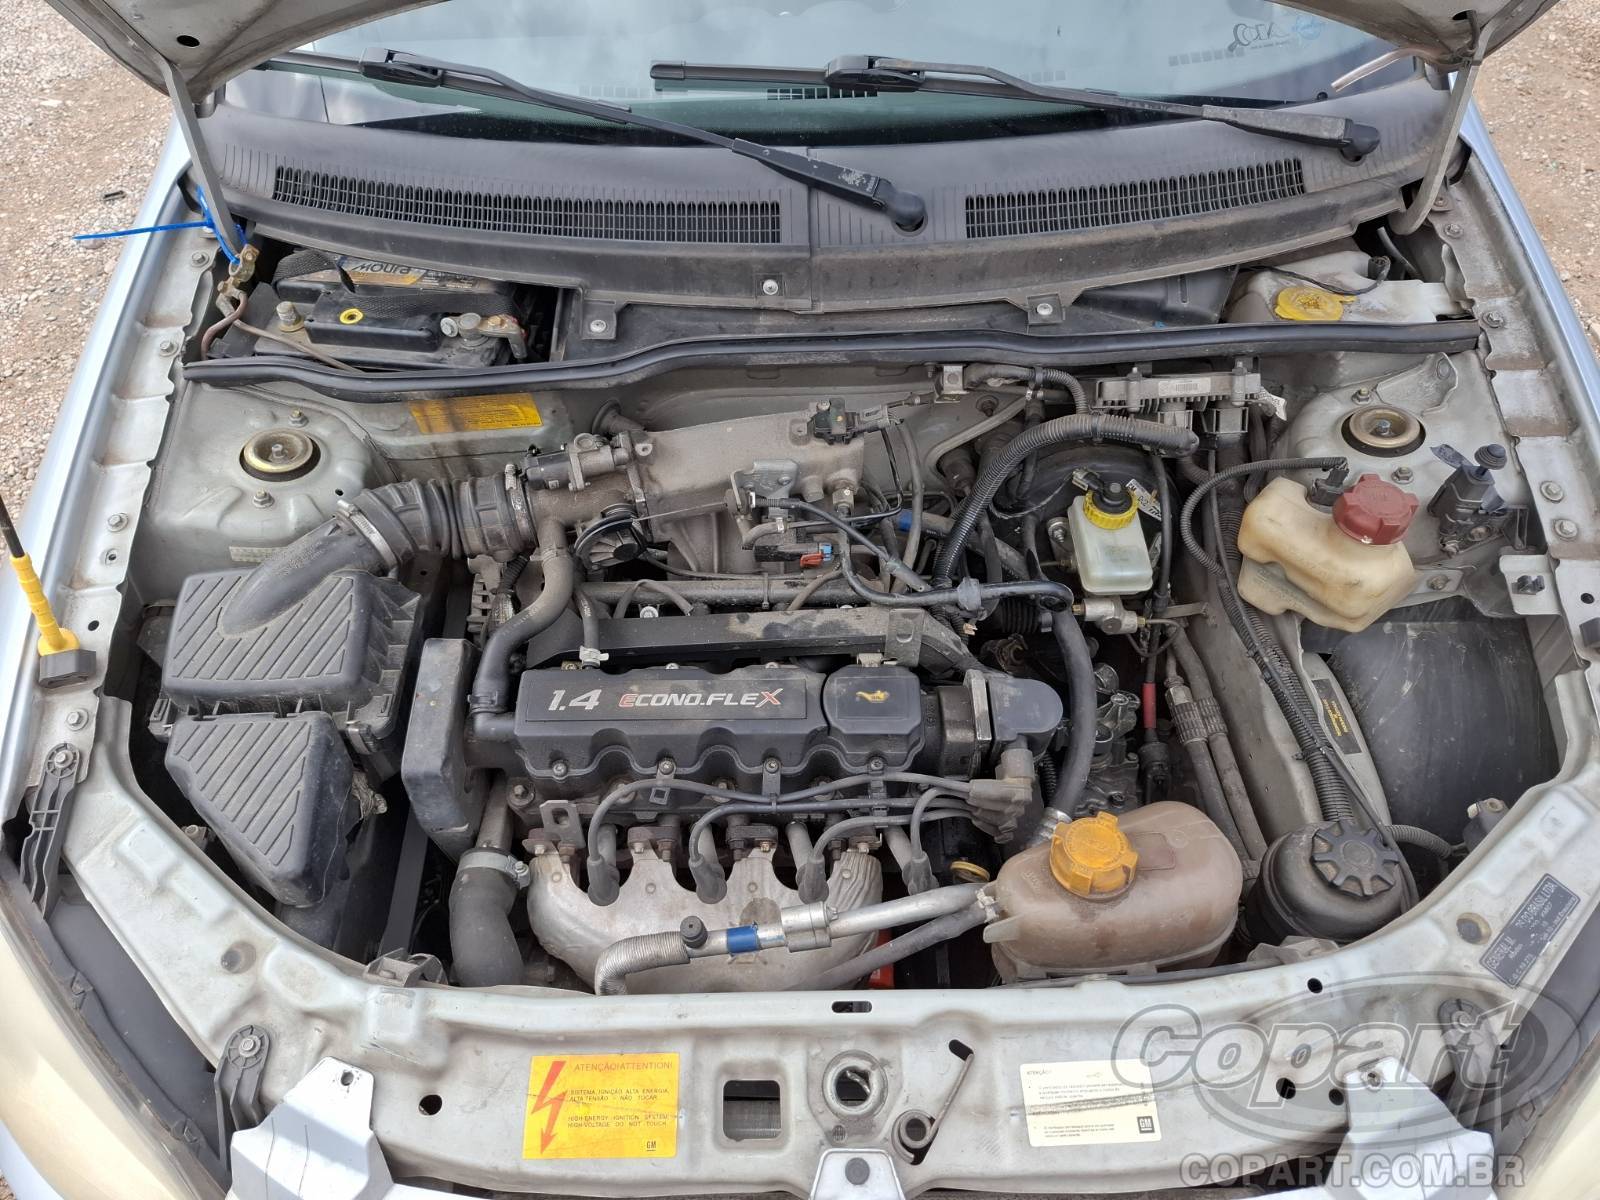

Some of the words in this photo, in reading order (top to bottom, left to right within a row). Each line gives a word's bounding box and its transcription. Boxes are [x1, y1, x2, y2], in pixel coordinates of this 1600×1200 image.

[548, 689, 602, 711] 1.4
[1139, 1118, 1152, 1130] GM
[646, 1140, 656, 1149] GM
